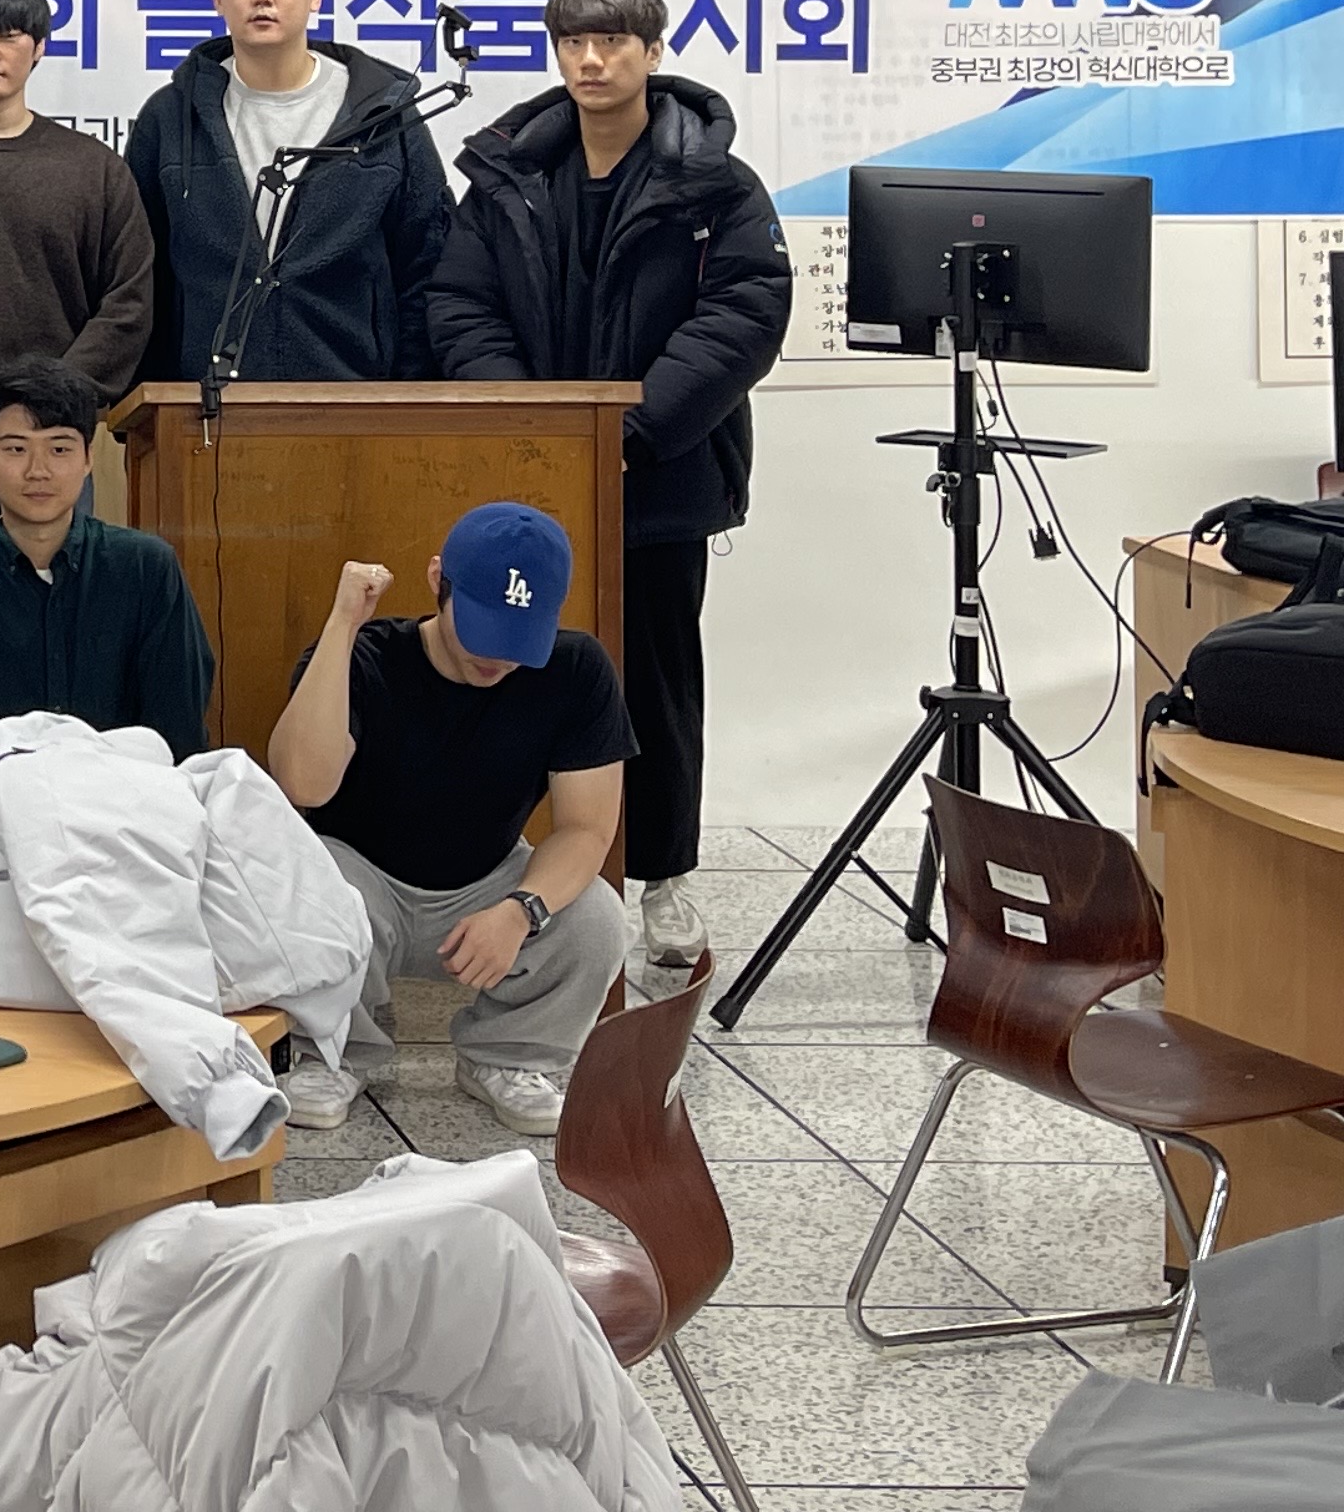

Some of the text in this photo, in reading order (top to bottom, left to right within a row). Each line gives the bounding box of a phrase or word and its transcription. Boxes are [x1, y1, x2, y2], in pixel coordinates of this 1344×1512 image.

[944, 20, 1216, 48] 대전 최초의 사립대학에서
[931, 56, 1002, 84] 중부권
[1007, 56, 1082, 83] 최강의
[1087, 54, 1229, 83] 혁신대학으로
[505, 567, 532, 608] LA
